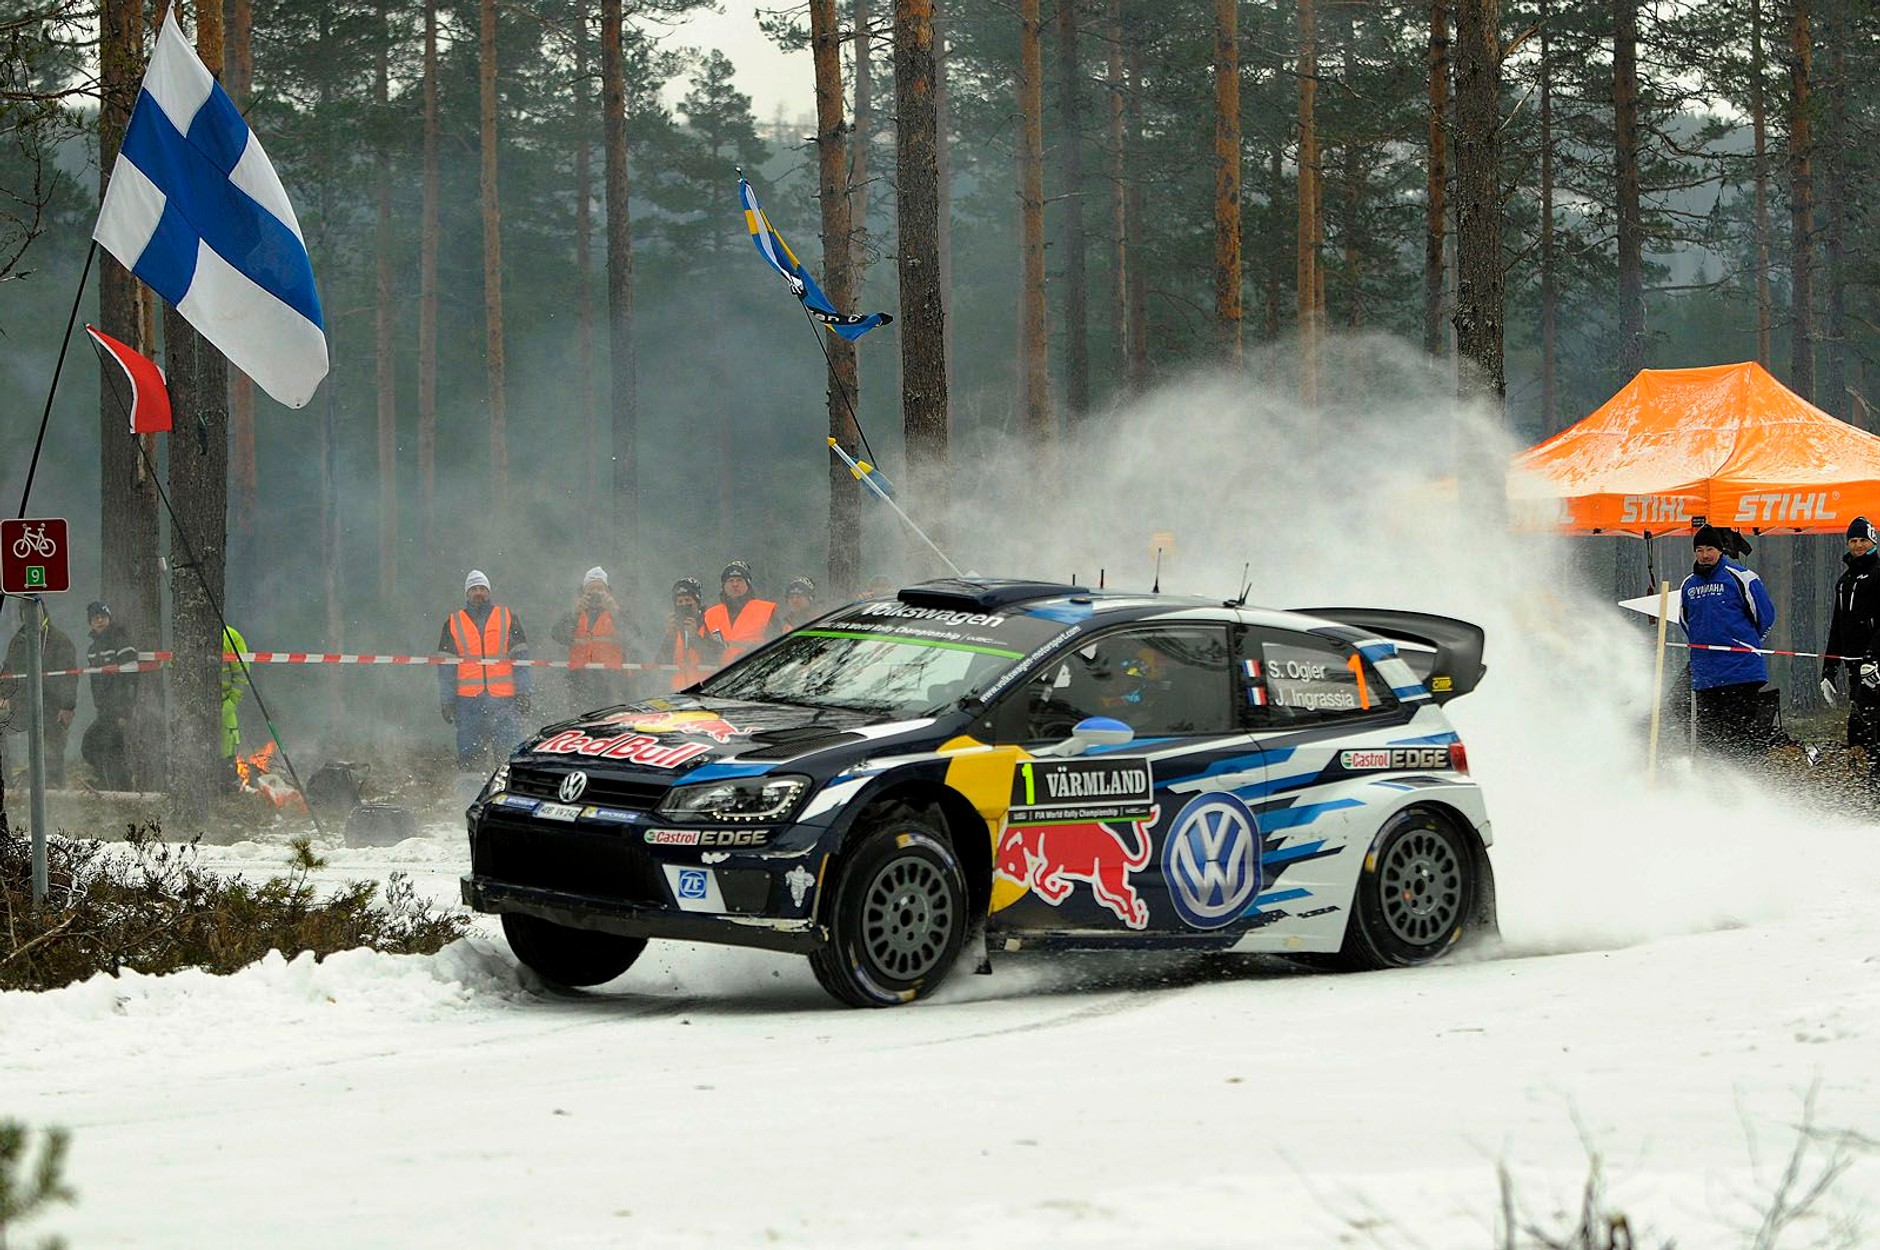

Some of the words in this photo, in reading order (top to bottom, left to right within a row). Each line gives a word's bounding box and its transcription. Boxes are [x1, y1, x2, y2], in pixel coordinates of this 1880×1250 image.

[1620, 496, 1691, 523] STIHL
[1735, 492, 1837, 520] STIHL
[31, 569, 40, 583] 9
[1696, 583, 1725, 595] YAMAHA
[861, 602, 1005, 628] Volkswagen
[894, 626, 961, 641] Championship
[979, 625, 1082, 703] www.volkswagen-motorsport.com
[1268, 661, 1284, 678] S.
[1287, 660, 1326, 682] Ogier
[1347, 653, 1371, 711] 1
[1275, 690, 1290, 706] J.
[1291, 689, 1355, 711] Ingrassia
[533, 730, 634, 756] Red
[600, 734, 714, 769] Bull
[1352, 751, 1389, 768] Castrol
[1391, 749, 1449, 768] EDGE
[1021, 762, 1035, 806] 1
[1046, 766, 1147, 798] VÄRMLAND
[1046, 810, 1062, 819] World
[1063, 809, 1079, 819] Rally
[1078, 808, 1118, 818] Championship
[655, 831, 698, 844] Castrol
[699, 829, 770, 846] EDGE
